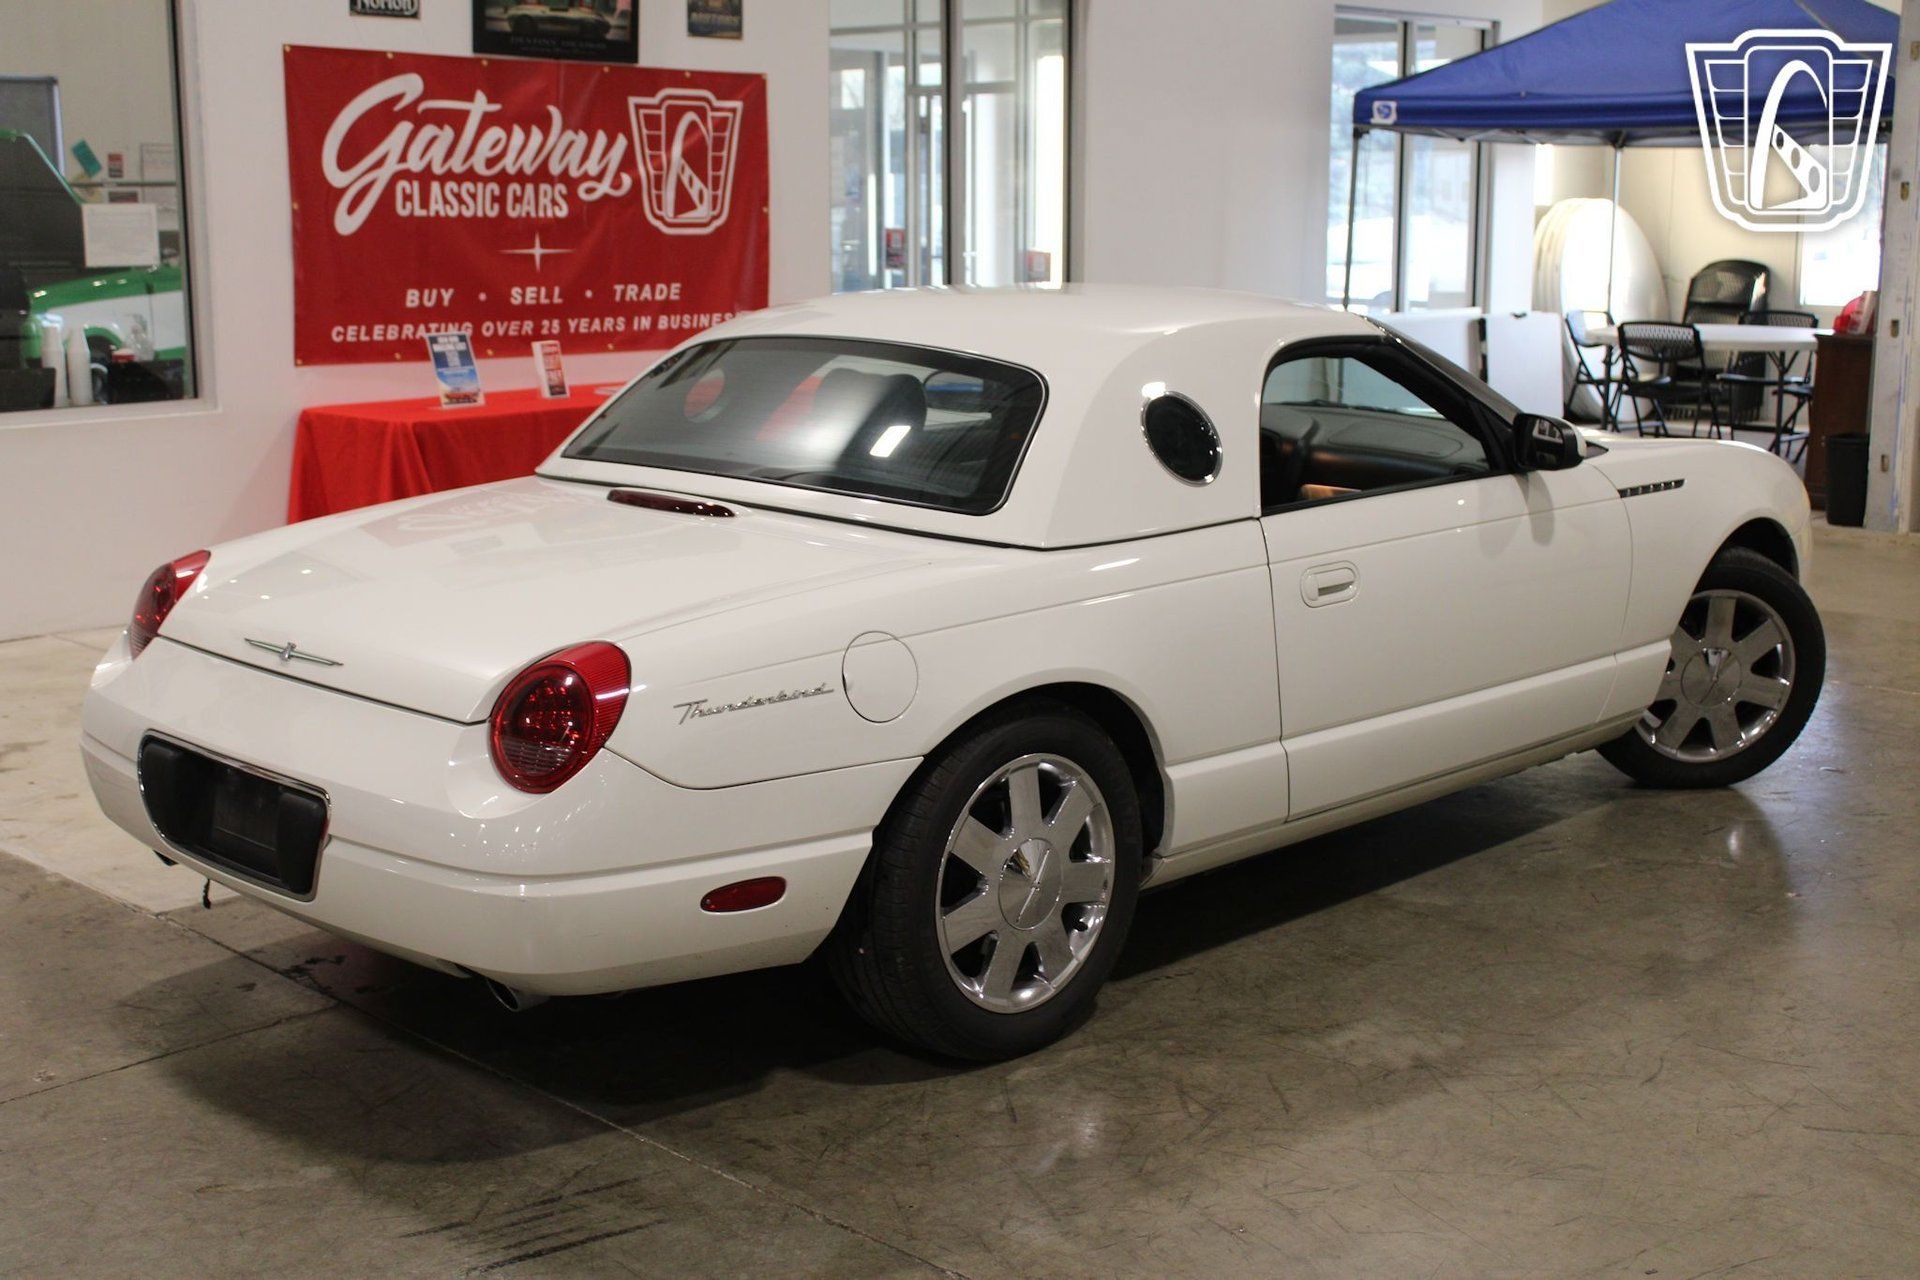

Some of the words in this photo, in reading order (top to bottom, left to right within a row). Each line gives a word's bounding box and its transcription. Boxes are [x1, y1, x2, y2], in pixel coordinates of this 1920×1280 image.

[321, 72, 633, 236] Gateway
[395, 179, 501, 218] CLASSIC
[506, 180, 570, 219] CARS
[405, 288, 455, 308] BUY
[510, 286, 564, 305] SELL
[613, 282, 682, 302] TRADE
[331, 321, 474, 343] CELEBRATING
[481, 320, 535, 338] OVER
[540, 318, 561, 336] 25
[567, 316, 626, 334] YEARS
[633, 315, 652, 332] IN
[657, 311, 736, 330] BUSINES
[672, 682, 835, 725] Thunderbird
